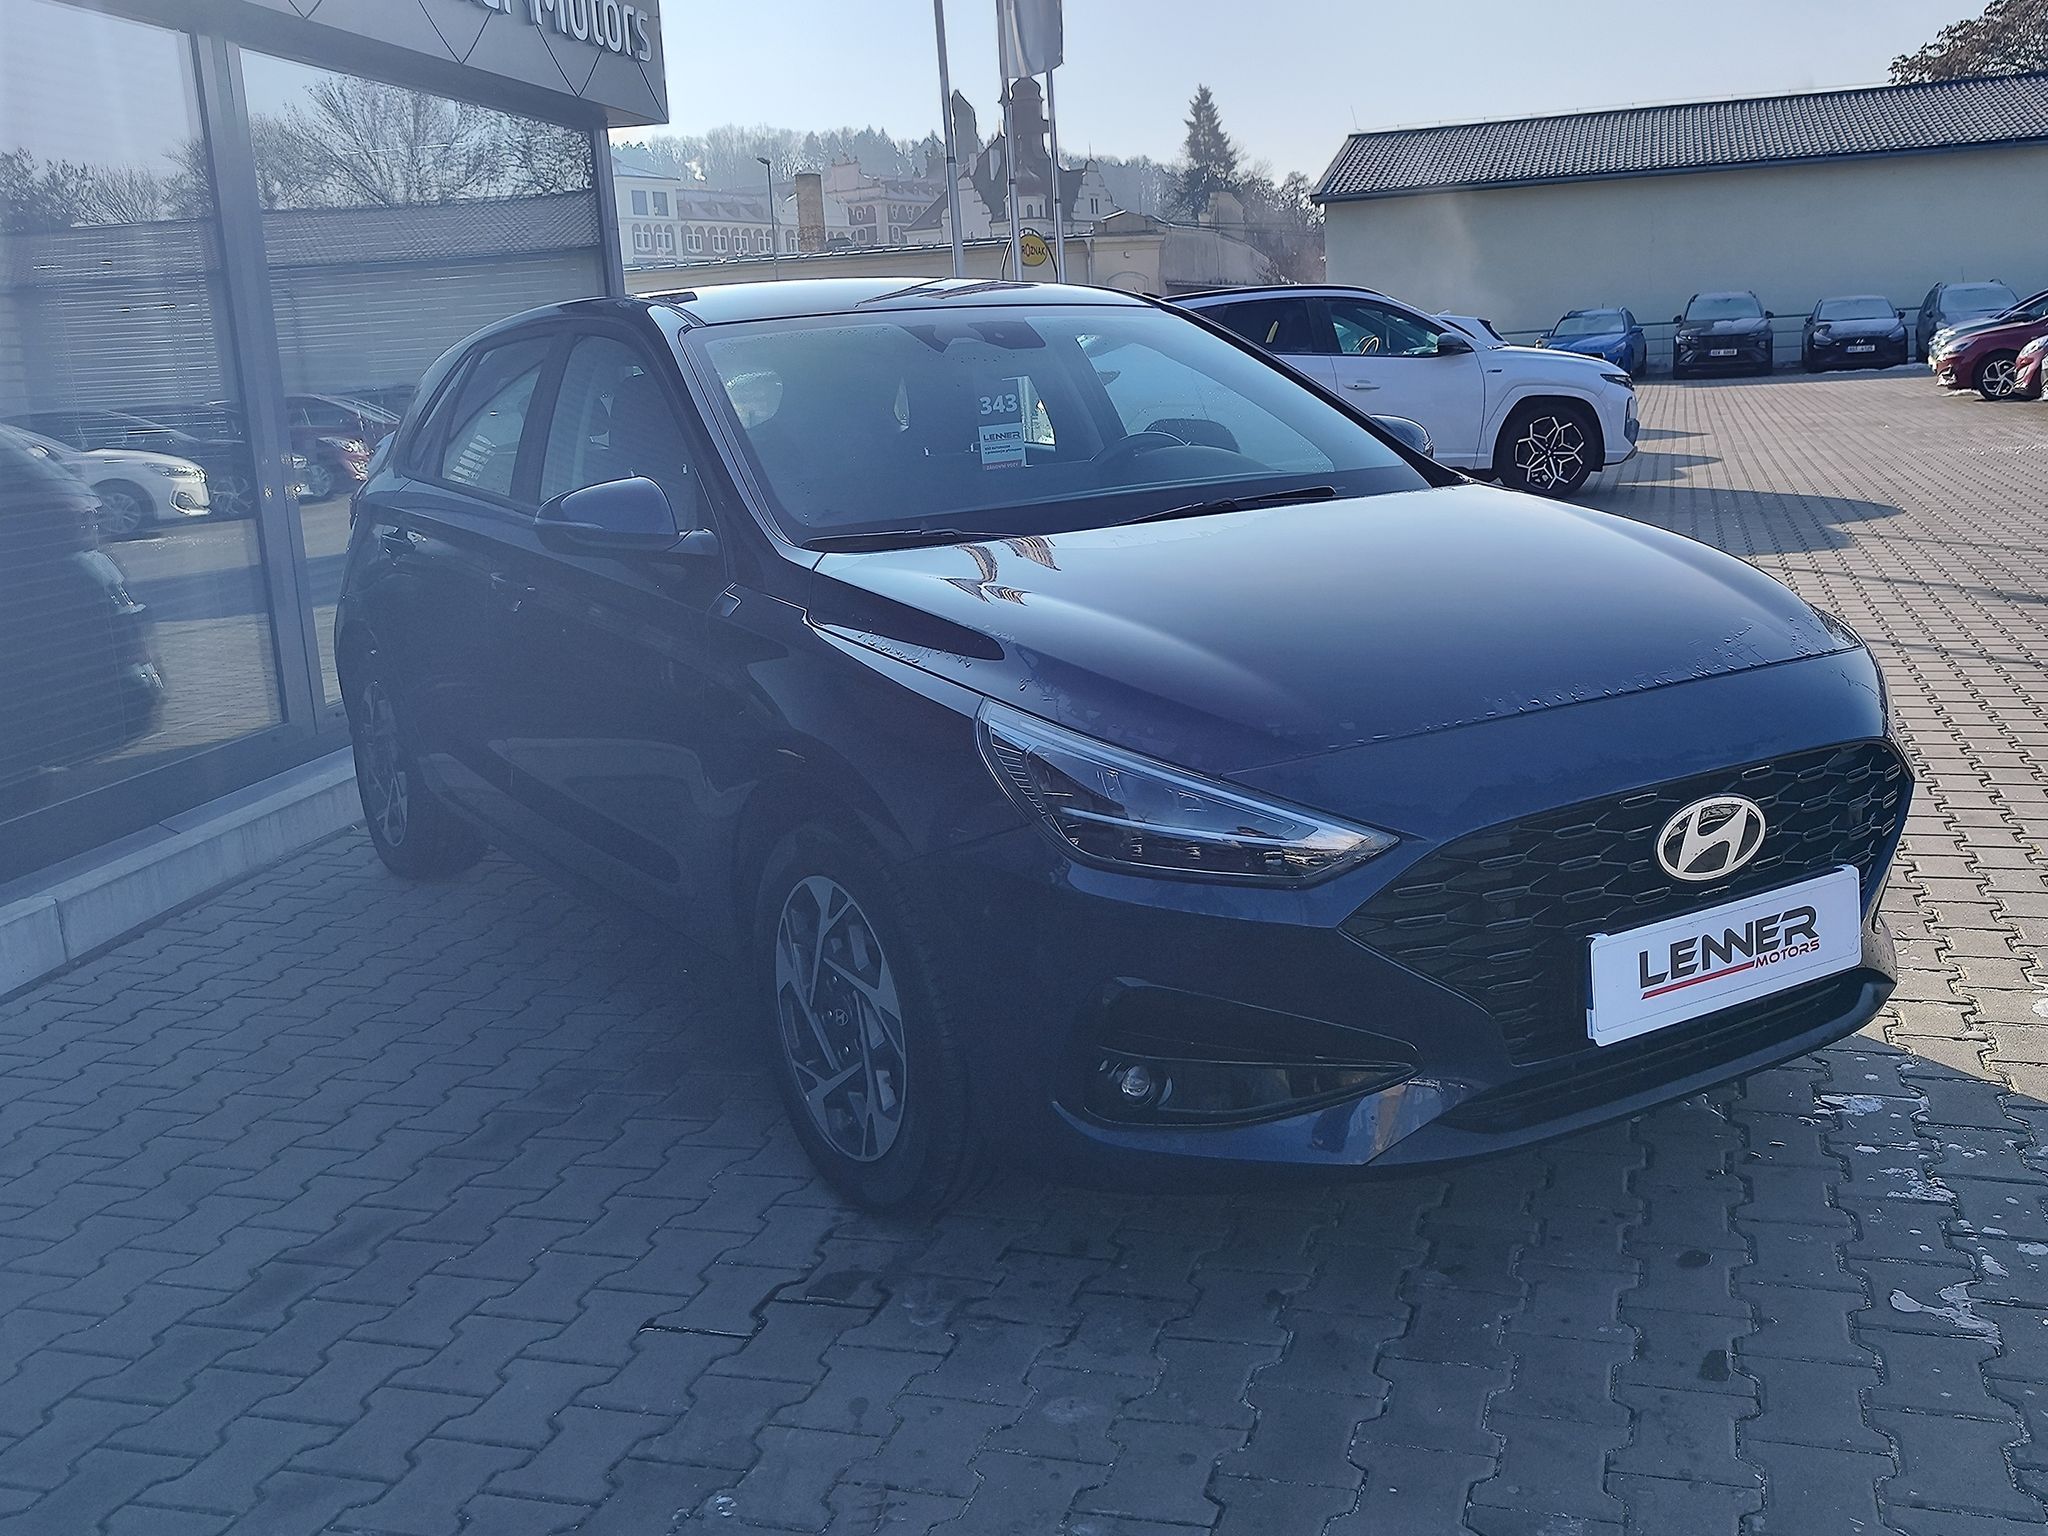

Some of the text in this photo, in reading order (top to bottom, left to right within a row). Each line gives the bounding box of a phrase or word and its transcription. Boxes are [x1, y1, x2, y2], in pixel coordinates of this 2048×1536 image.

[979, 393, 1018, 415] 343
[983, 431, 1021, 441] LENNER
[1638, 905, 1820, 989] LENNER
[1754, 938, 1820, 969] MOTORS
